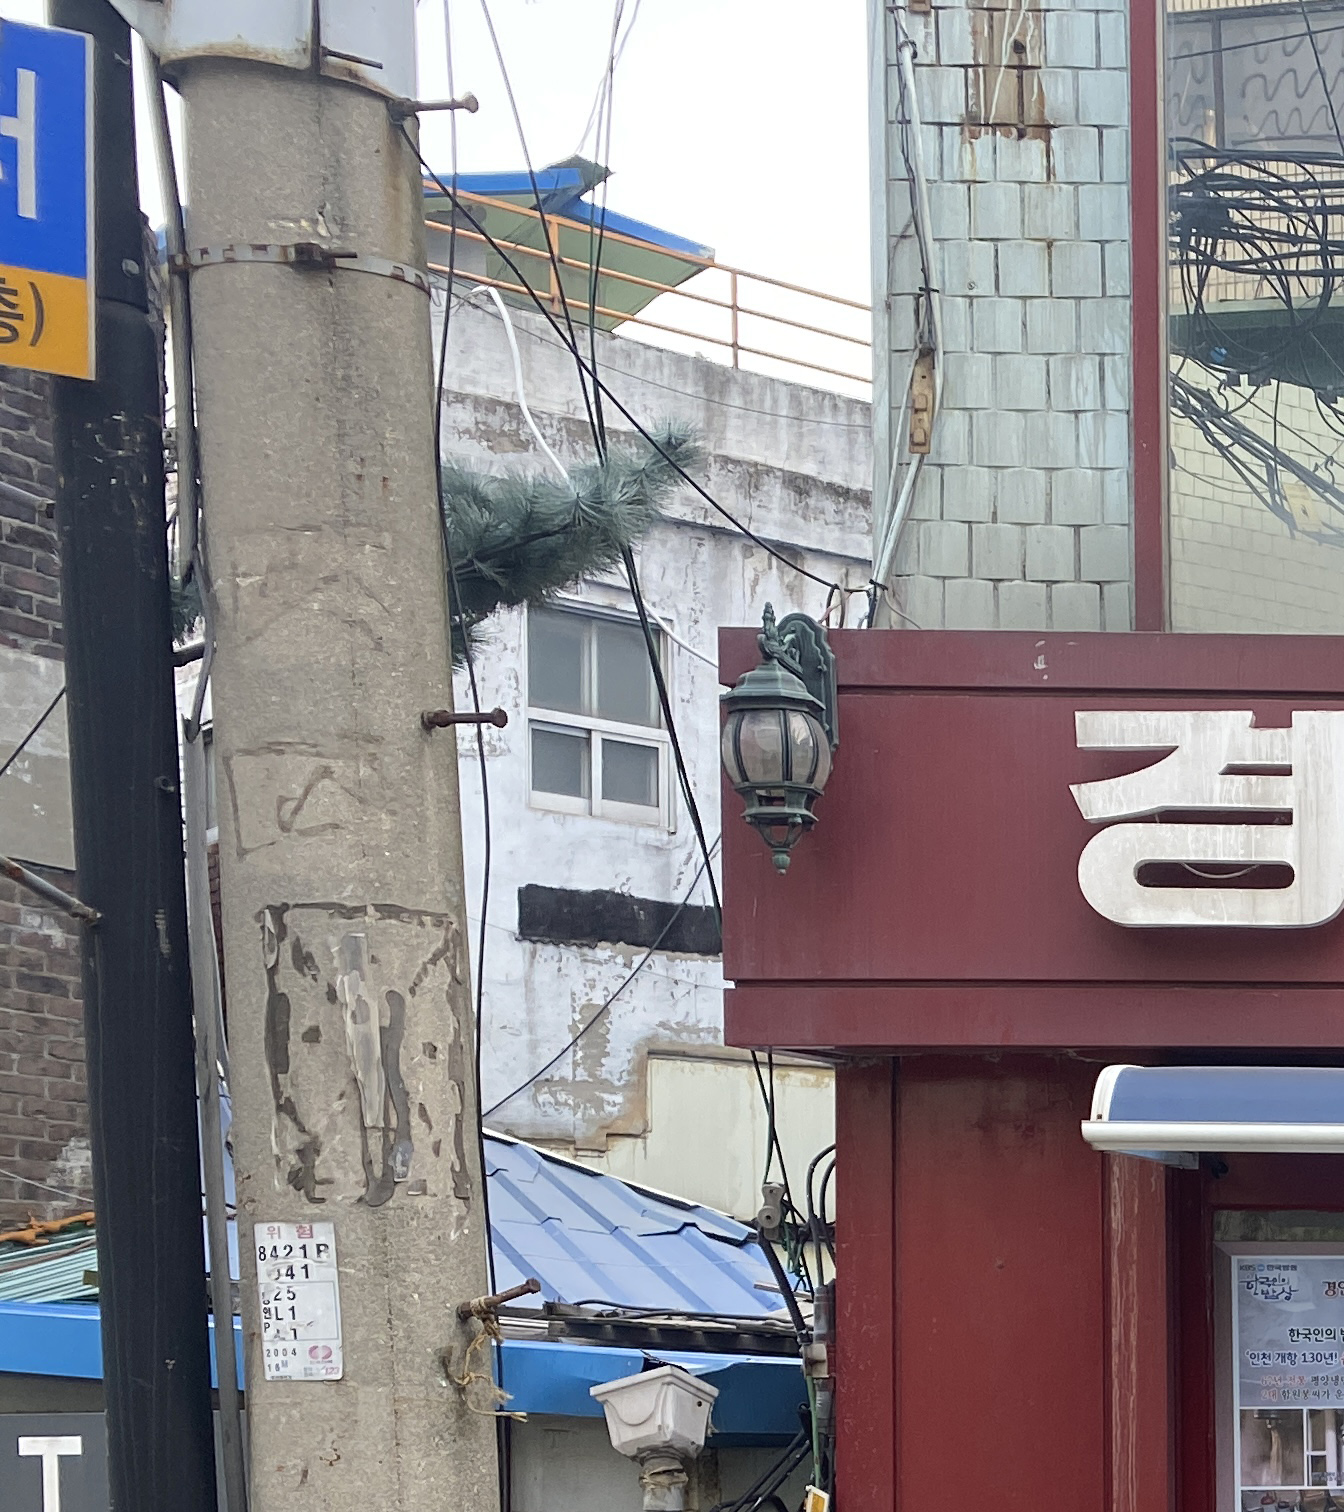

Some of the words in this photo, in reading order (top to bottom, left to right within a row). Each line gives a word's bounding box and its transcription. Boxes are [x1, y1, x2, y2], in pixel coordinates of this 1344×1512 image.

[1288, 1327, 1337, 1343] 한국인의
[1274, 1351, 1298, 1366] 개항
[1301, 1351, 1338, 1366] 130년!
